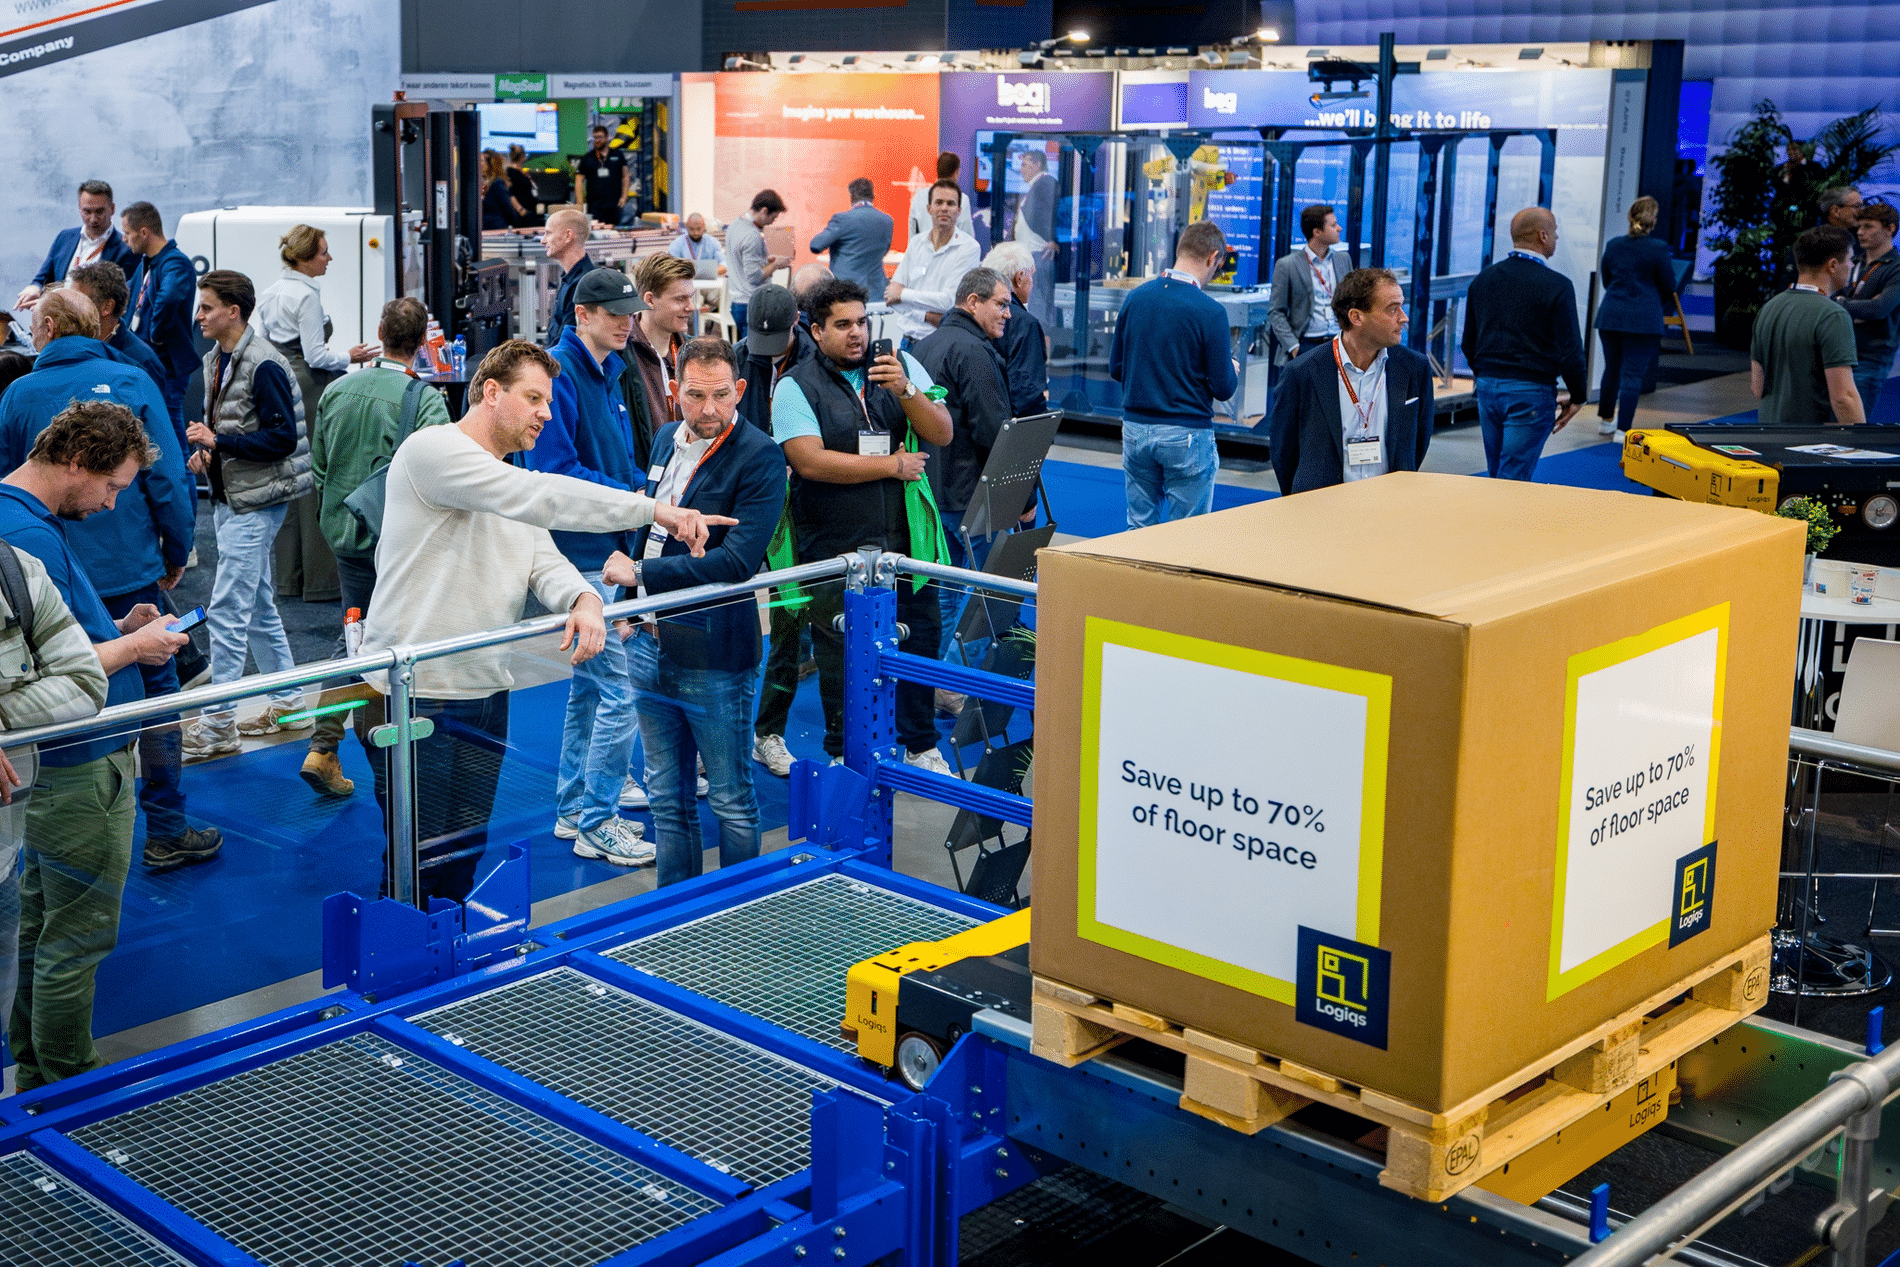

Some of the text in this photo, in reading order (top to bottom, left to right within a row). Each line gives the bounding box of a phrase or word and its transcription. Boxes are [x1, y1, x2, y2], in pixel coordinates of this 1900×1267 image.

[0, 36, 74, 66] Company
[782, 104, 825, 122] Imagine
[826, 108, 851, 122] your
[1364, 109, 1414, 128] bng
[1417, 110, 1431, 128] it
[1435, 111, 1456, 128] to
[1460, 111, 1491, 129] life
[1585, 744, 1695, 811] Save up to 70%
[1121, 760, 1325, 833] Save up to 70%
[1590, 787, 1689, 846] of floor space
[1132, 804, 1317, 870] of floor space
[1679, 909, 1703, 929] Logiqs
[1747, 972, 1765, 996] EPA
[858, 1014, 887, 1034] Logiqs
[1316, 998, 1367, 1027] Logiqs
[1629, 1098, 1662, 1128] Logiqs
[1450, 1142, 1475, 1174] EPAL
